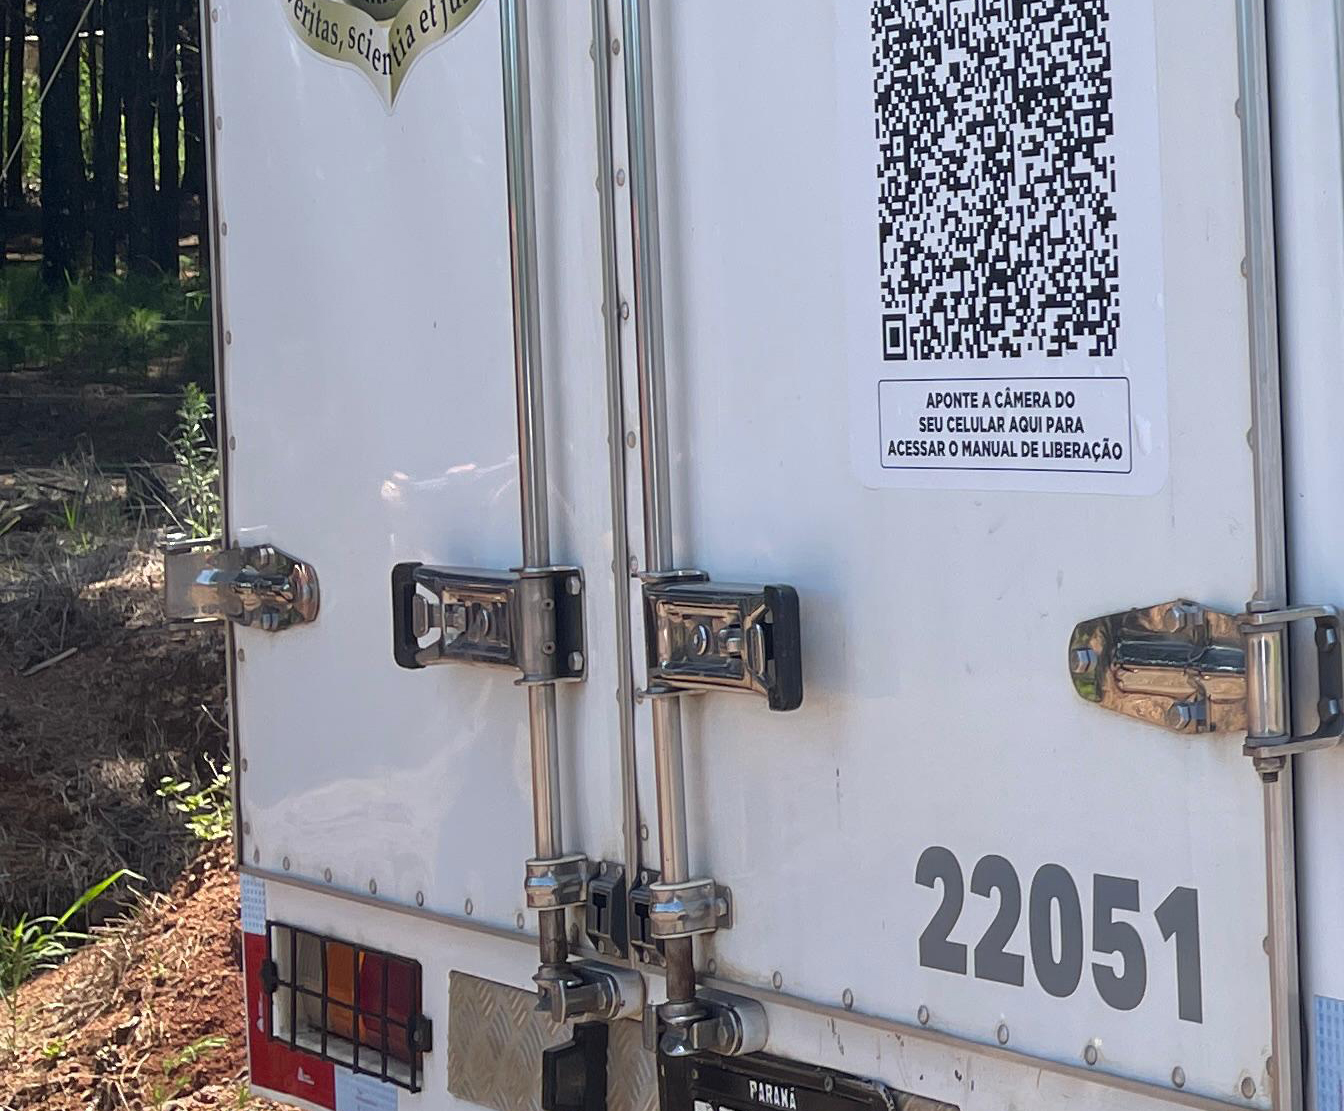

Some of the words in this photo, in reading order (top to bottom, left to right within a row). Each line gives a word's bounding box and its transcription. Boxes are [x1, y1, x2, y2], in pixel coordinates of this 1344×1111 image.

[348, 23, 416, 76] scientia
[926, 391, 978, 409] APONTE
[981, 391, 991, 409] A
[994, 387, 1050, 409] CÂMERA
[1055, 391, 1075, 409] DO
[918, 416, 943, 433] SEU
[946, 416, 1004, 433] CELULAR
[1009, 416, 1042, 435] AQUI
[1046, 416, 1085, 434] PARA
[887, 440, 945, 457] ACESSAR
[950, 440, 958, 457] O
[962, 440, 1017, 458] MANUAL
[1021, 441, 1039, 458] DE
[1042, 438, 1122, 462] LIBERAÇÃO
[914, 846, 1203, 1024] 22051
[749, 1080, 797, 1110] PARANÁ
